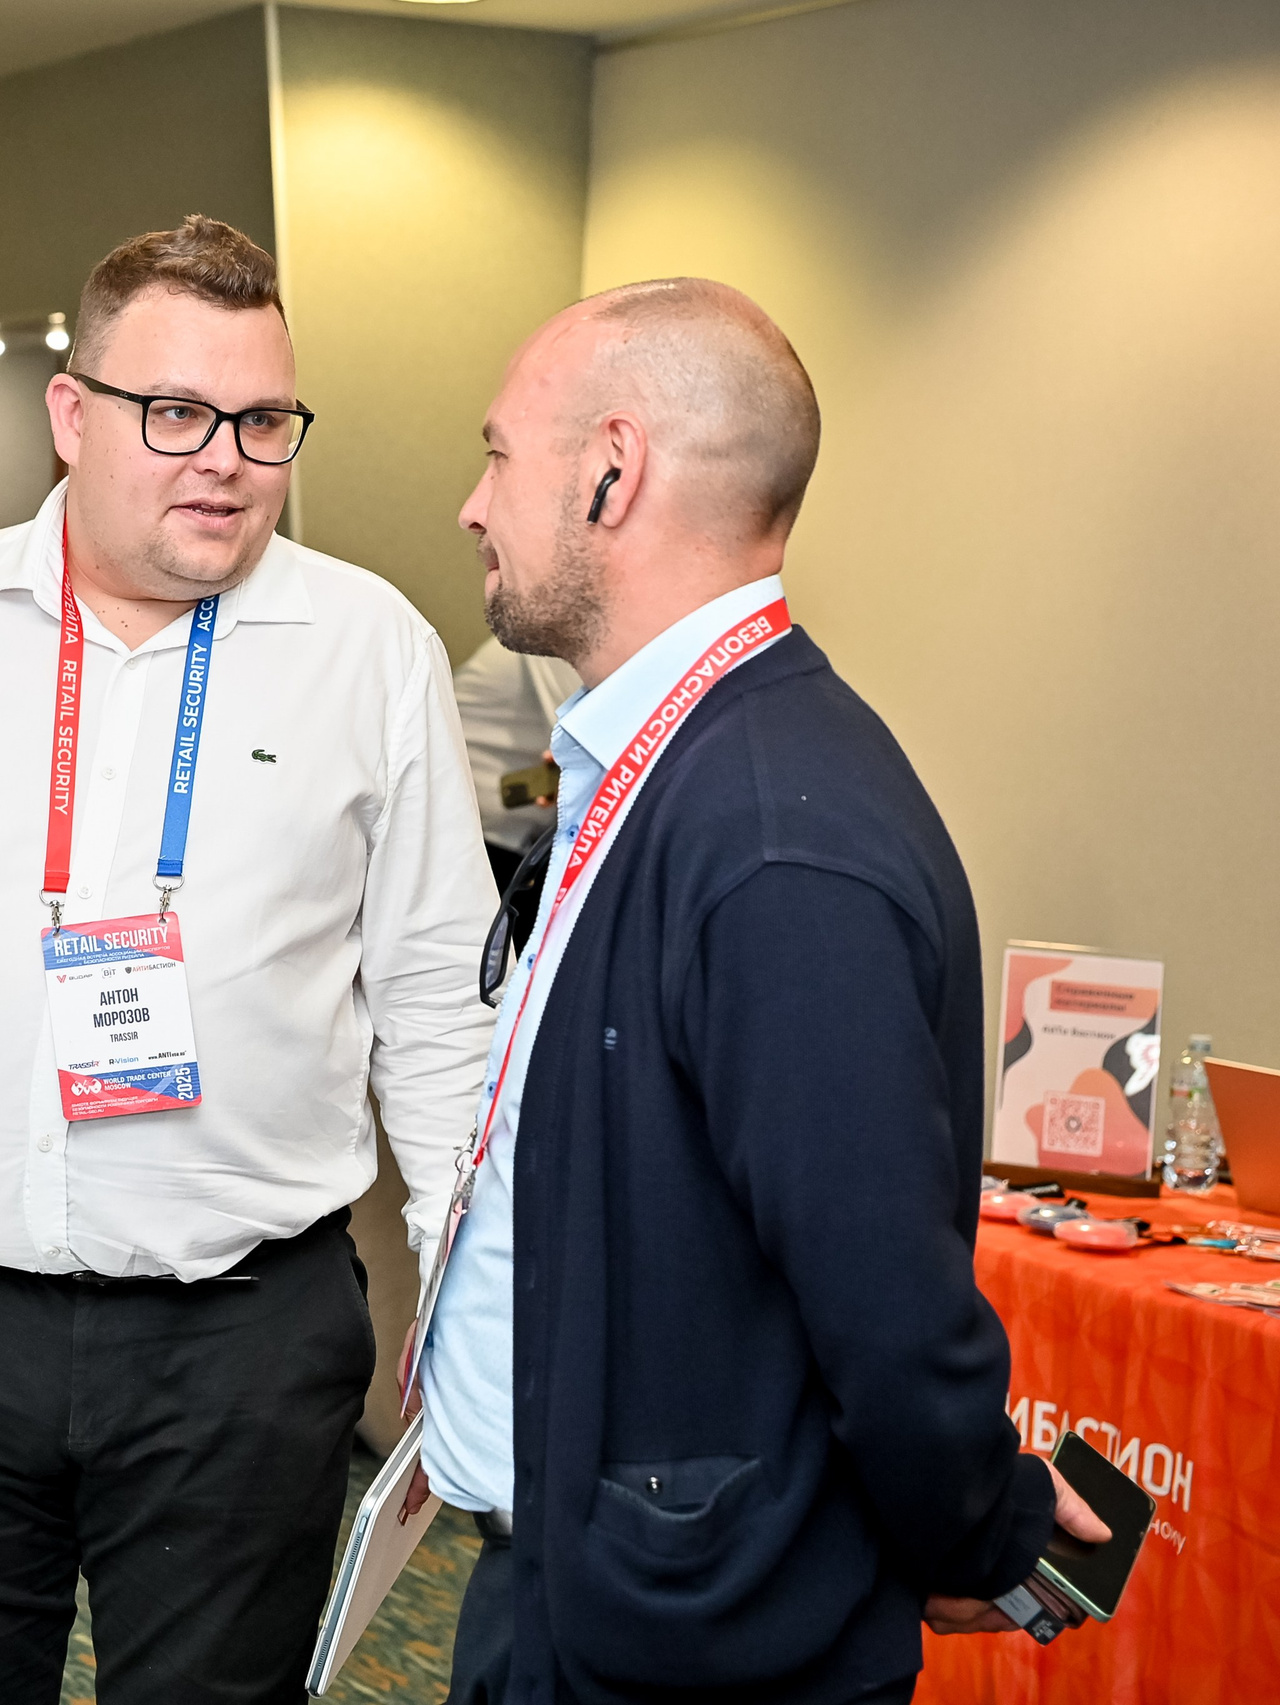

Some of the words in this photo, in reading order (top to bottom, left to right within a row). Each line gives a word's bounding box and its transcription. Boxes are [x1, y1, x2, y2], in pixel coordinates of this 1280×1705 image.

[60, 659, 77, 721] RETAIL
[183, 642, 208, 729] SECURITY
[628, 615, 773, 767] БЕЗОПАСНОСТИ
[54, 726, 74, 815] SECURITY
[173, 731, 196, 794] RETAIL
[567, 772, 635, 869] РИТЕЙЛА
[54, 935, 101, 957] RETAIL
[104, 926, 169, 950] SECURITY
[132, 962, 177, 973] АЙТИБАСТИОН
[100, 987, 140, 1007] АНТОН
[93, 1008, 151, 1028] МОРОЗОВ
[109, 1031, 139, 1043] TRASSIR
[104, 1076, 126, 1085] WORLD
[126, 1074, 147, 1082] TRADE
[147, 1071, 172, 1080] CENTER
[104, 1083, 132, 1091] MOSCOW
[175, 1067, 194, 1100] 2025
